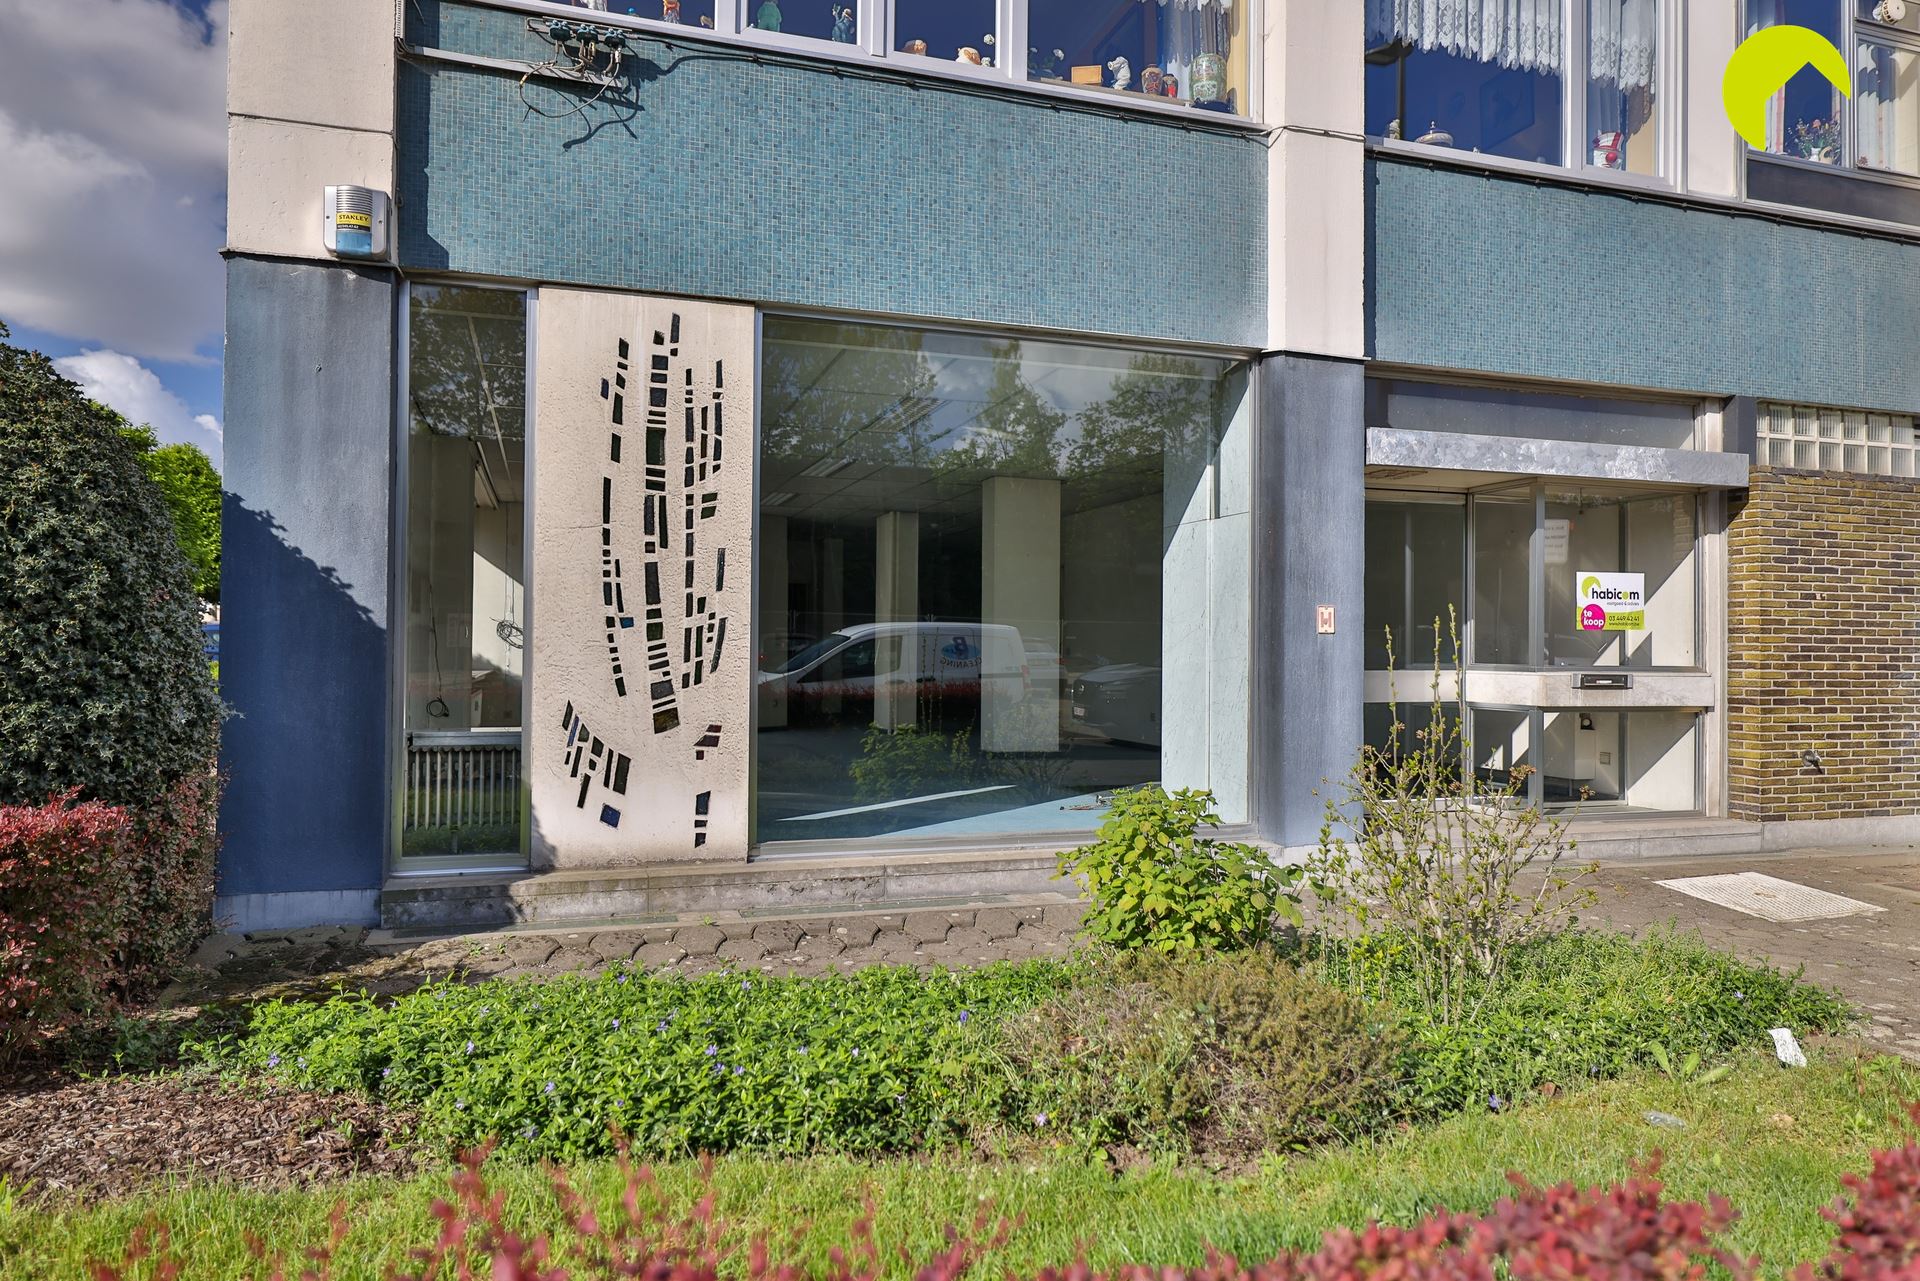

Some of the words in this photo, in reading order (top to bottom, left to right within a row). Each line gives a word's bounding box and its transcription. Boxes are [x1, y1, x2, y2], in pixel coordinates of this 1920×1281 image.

[1592, 588, 1639, 600] habicom
[1583, 609, 1593, 617] te
[1583, 618, 1604, 628] koop
